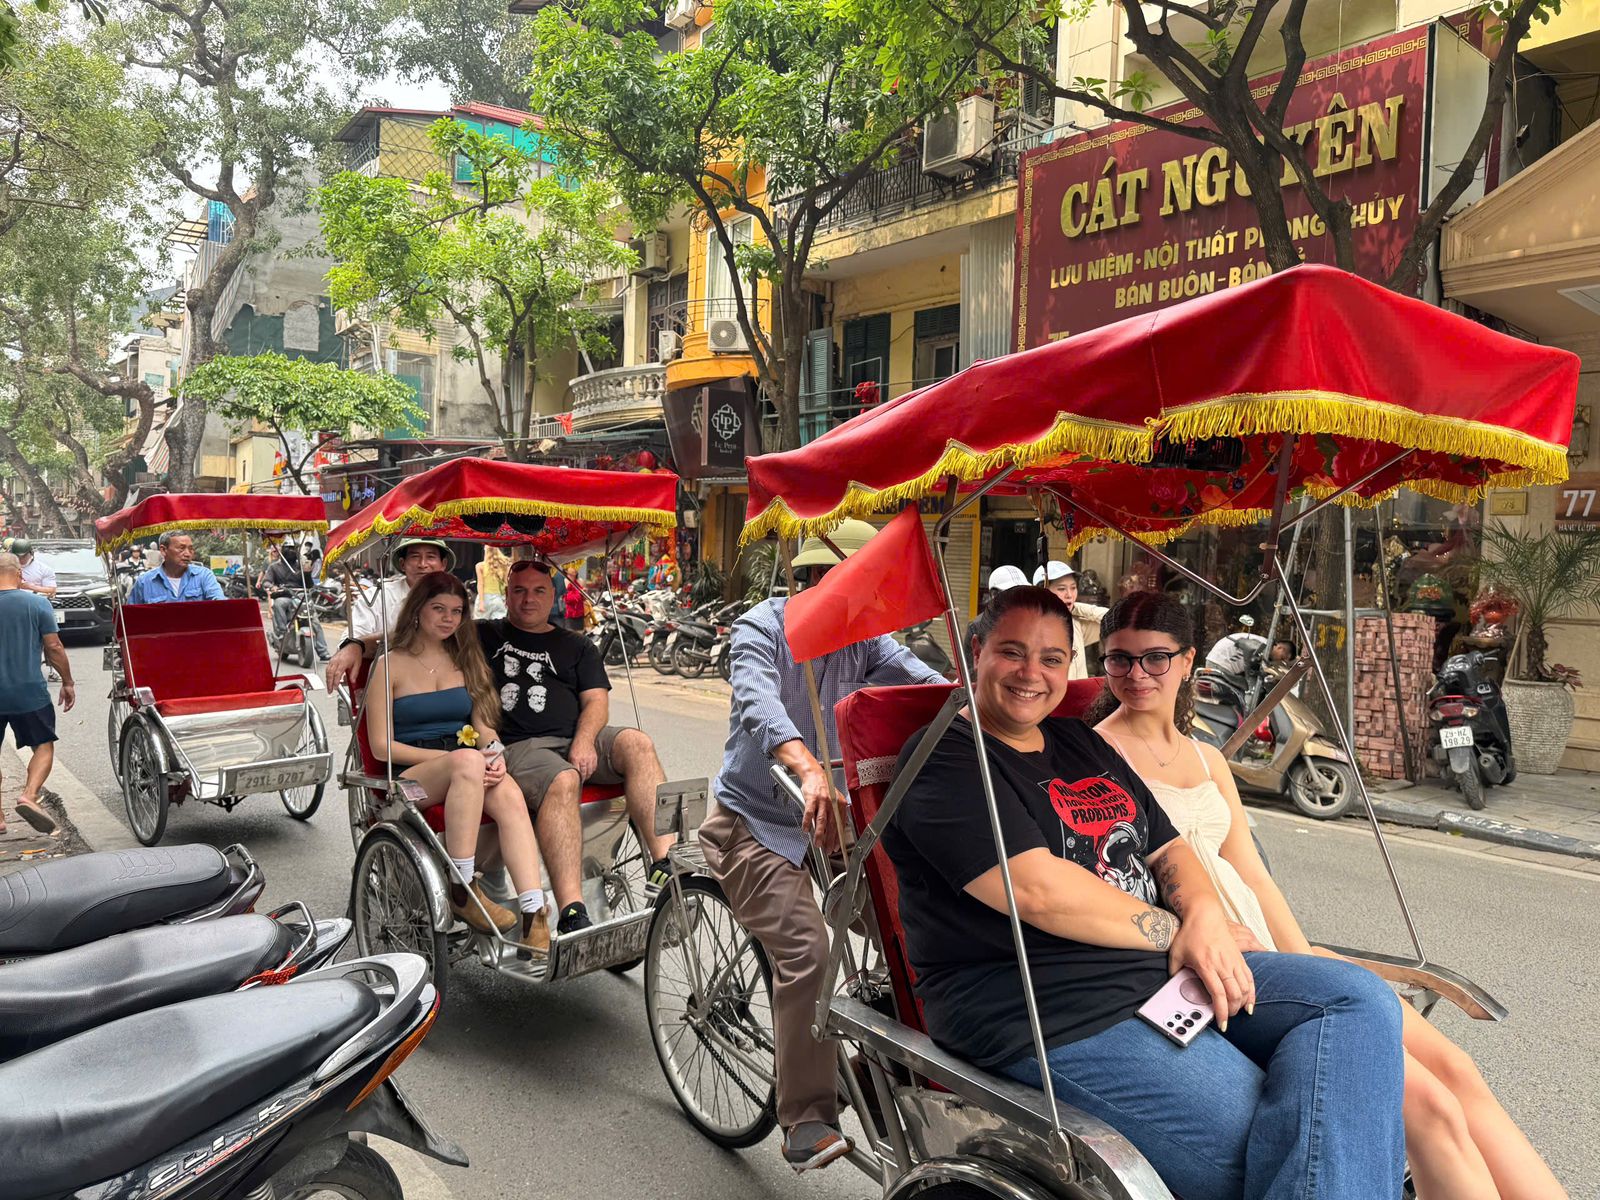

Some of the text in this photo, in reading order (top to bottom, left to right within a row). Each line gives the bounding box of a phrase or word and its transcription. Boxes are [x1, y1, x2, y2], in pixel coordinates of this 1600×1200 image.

[1060, 156, 1148, 238] CÁT
[1087, 252, 1134, 282] NIỆM
[1143, 240, 1179, 271] NỘI
[1185, 225, 1238, 261] THẤT
[1244, 213, 1326, 250] PNG
[1350, 192, 1405, 229] HỦY
[1114, 280, 1153, 309] BÁN
[1563, 489, 1597, 517] 77
